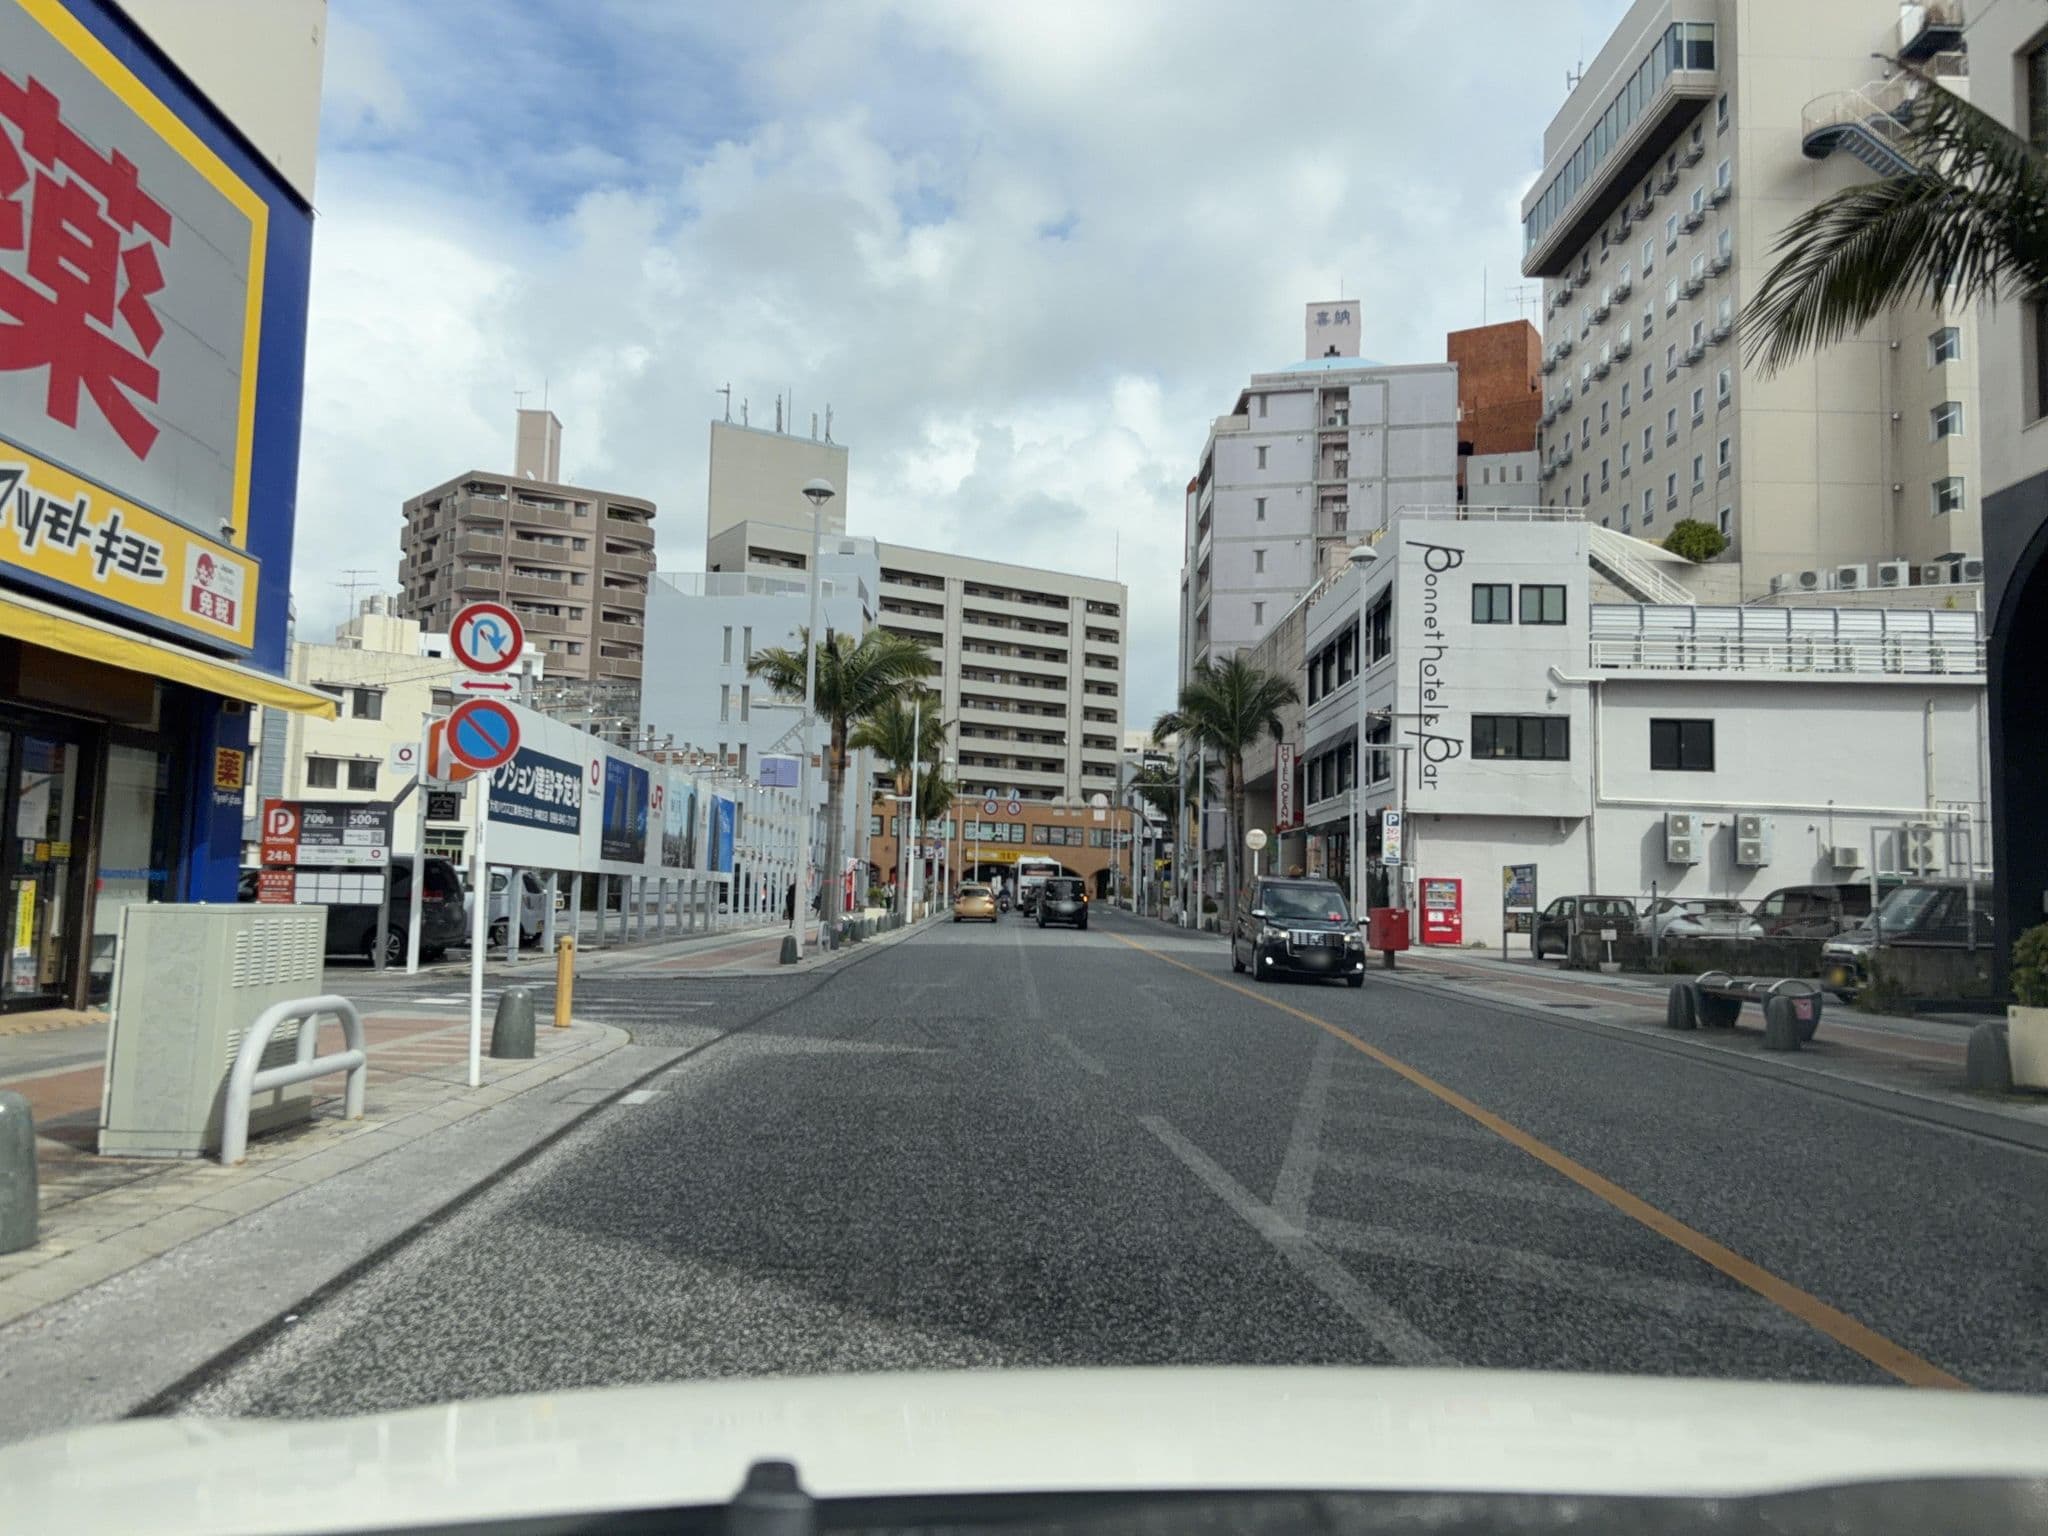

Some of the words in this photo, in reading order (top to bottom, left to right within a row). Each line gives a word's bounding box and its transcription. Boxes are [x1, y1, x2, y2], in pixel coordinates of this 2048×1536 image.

[0, 72, 173, 461] 薬
[199, 590, 230, 622] 免税
[1406, 541, 1464, 640] Bonnet
[1420, 645, 1449, 709] hotel
[218, 750, 241, 784] 薬
[1404, 730, 1464, 790] Bar
[303, 813, 334, 824] 700円
[349, 814, 380, 825] 500円
[1388, 814, 1399, 826] P
[266, 850, 292, 862] 24h
